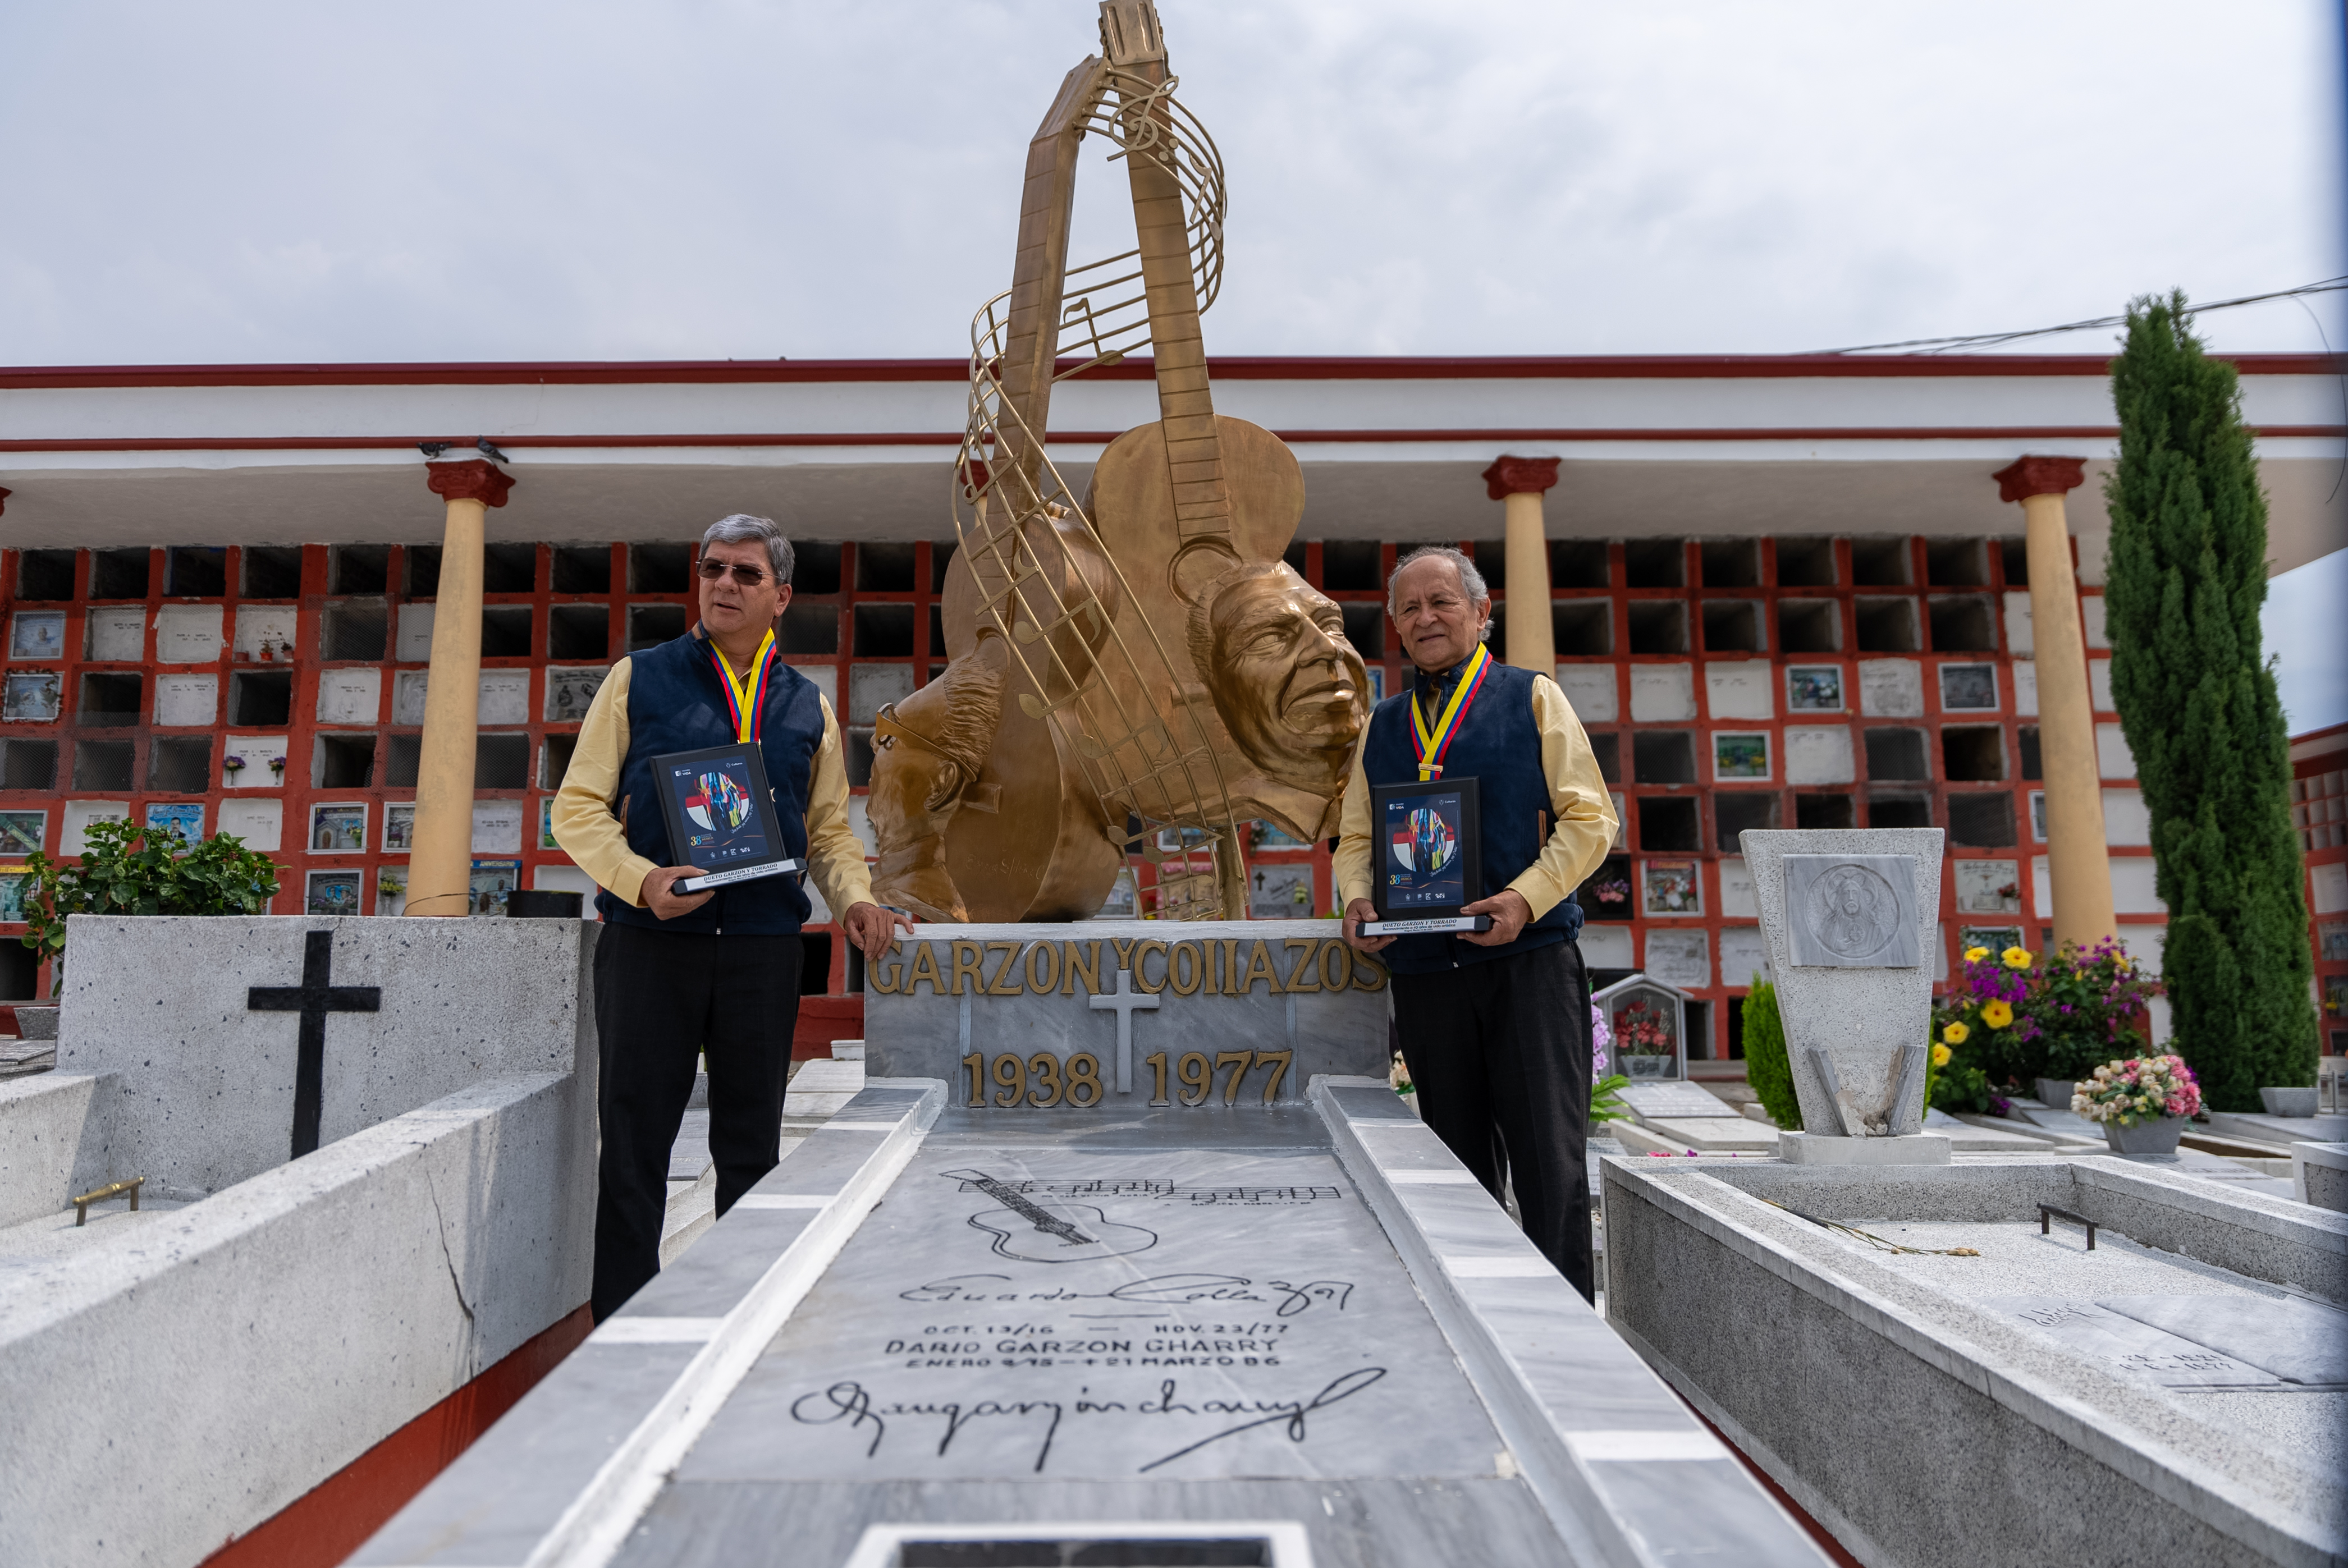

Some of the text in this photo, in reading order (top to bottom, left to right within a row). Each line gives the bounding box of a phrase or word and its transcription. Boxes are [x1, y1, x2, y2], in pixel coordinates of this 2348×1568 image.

[690, 835, 702, 846] 38
[751, 863, 778, 872] TORRADO
[1389, 874, 1400, 885] 38
[868, 940, 1102, 995] GARZON
[1111, 938, 1137, 969] Y
[963, 1053, 1102, 1107] 1938
[1146, 1051, 1292, 1107] 1977
[924, 1325, 977, 1335] OCT.
[986, 1323, 1054, 1336] 13/16
[1213, 1322, 1288, 1336] 23/77
[885, 1340, 981, 1354] DARIO
[996, 1339, 1131, 1354] GARZON
[905, 1359, 991, 1369] ENERO
[1141, 1356, 1235, 1367] MARZO
